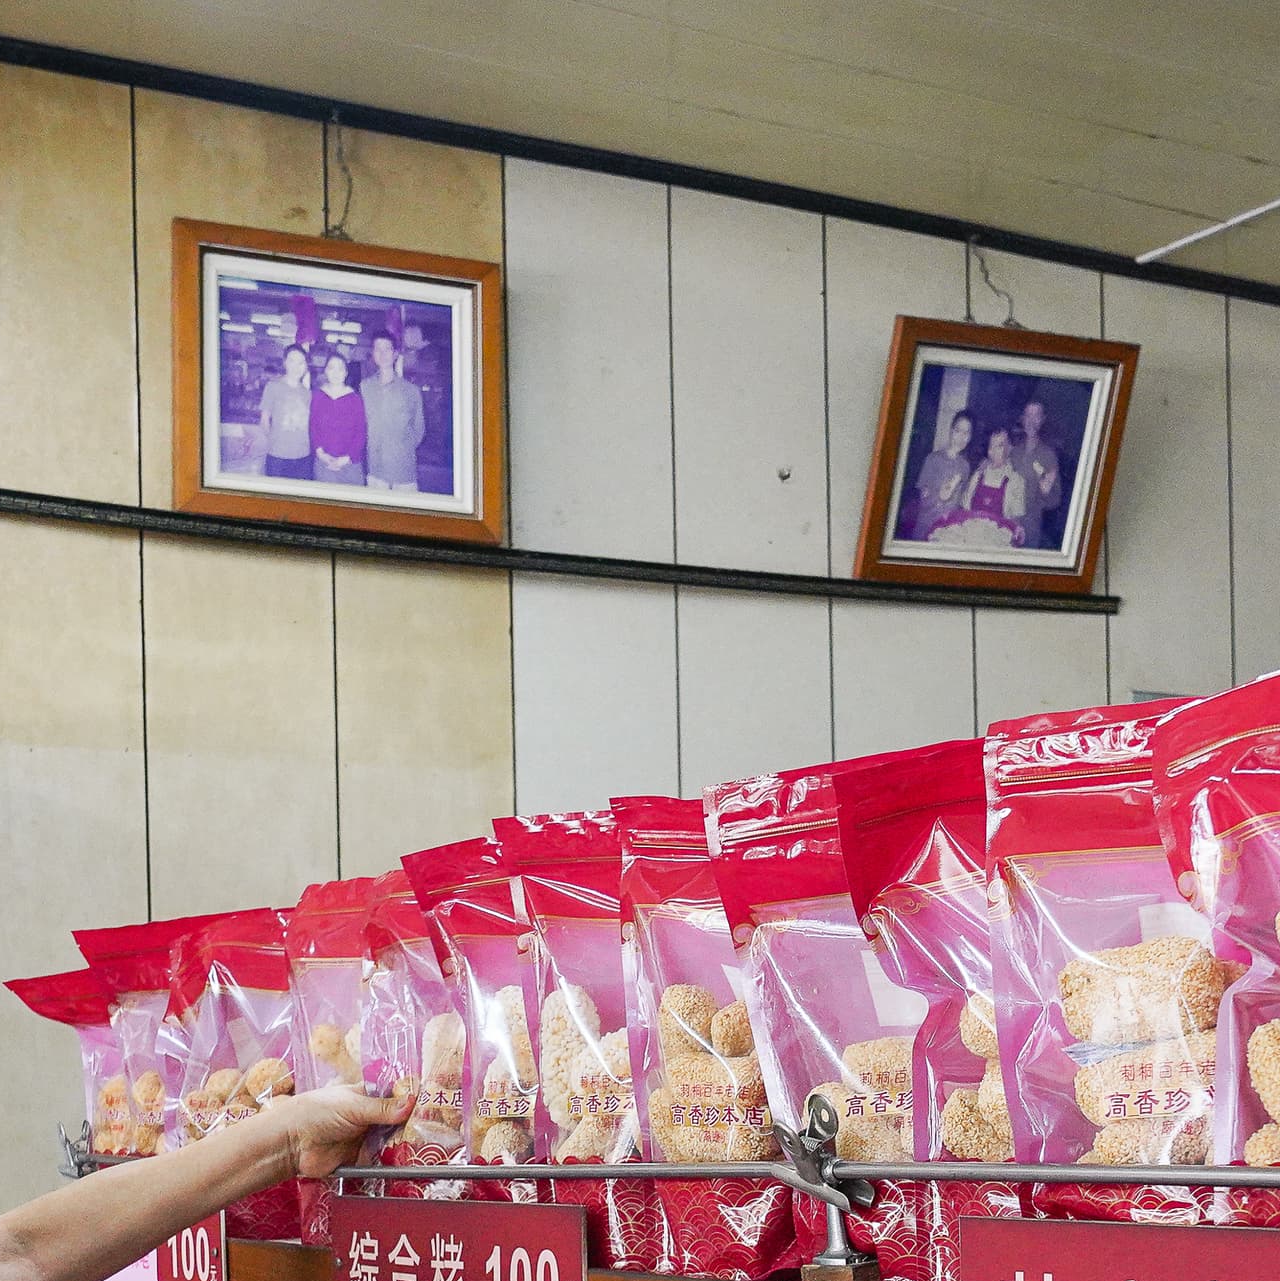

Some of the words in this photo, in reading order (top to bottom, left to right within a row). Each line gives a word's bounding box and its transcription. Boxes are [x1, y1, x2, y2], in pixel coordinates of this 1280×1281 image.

[671, 1104, 767, 1126] 高香珍本店
